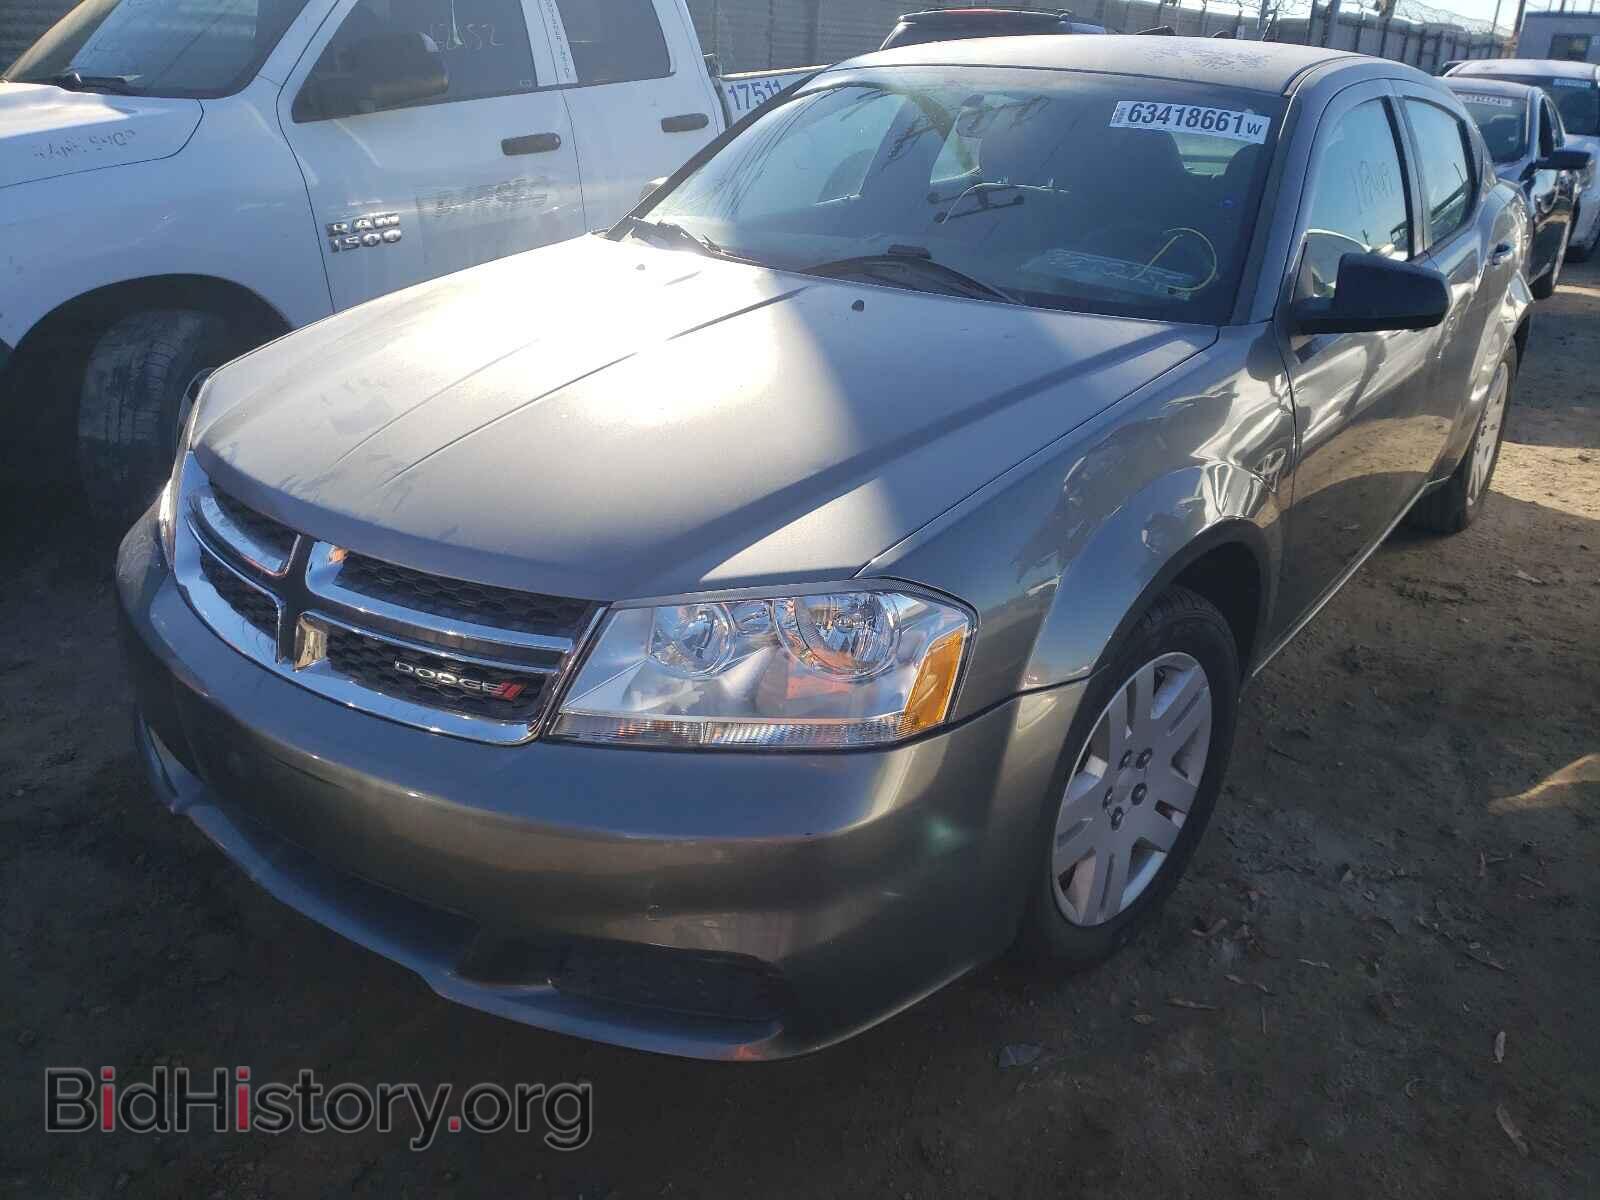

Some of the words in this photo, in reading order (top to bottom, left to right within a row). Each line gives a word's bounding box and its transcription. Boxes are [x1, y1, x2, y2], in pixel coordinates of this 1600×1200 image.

[1127, 102, 1244, 134] 63418661
[326, 212, 400, 237] RAM
[330, 230, 402, 253] 1500
[394, 660, 503, 695] DODGE
